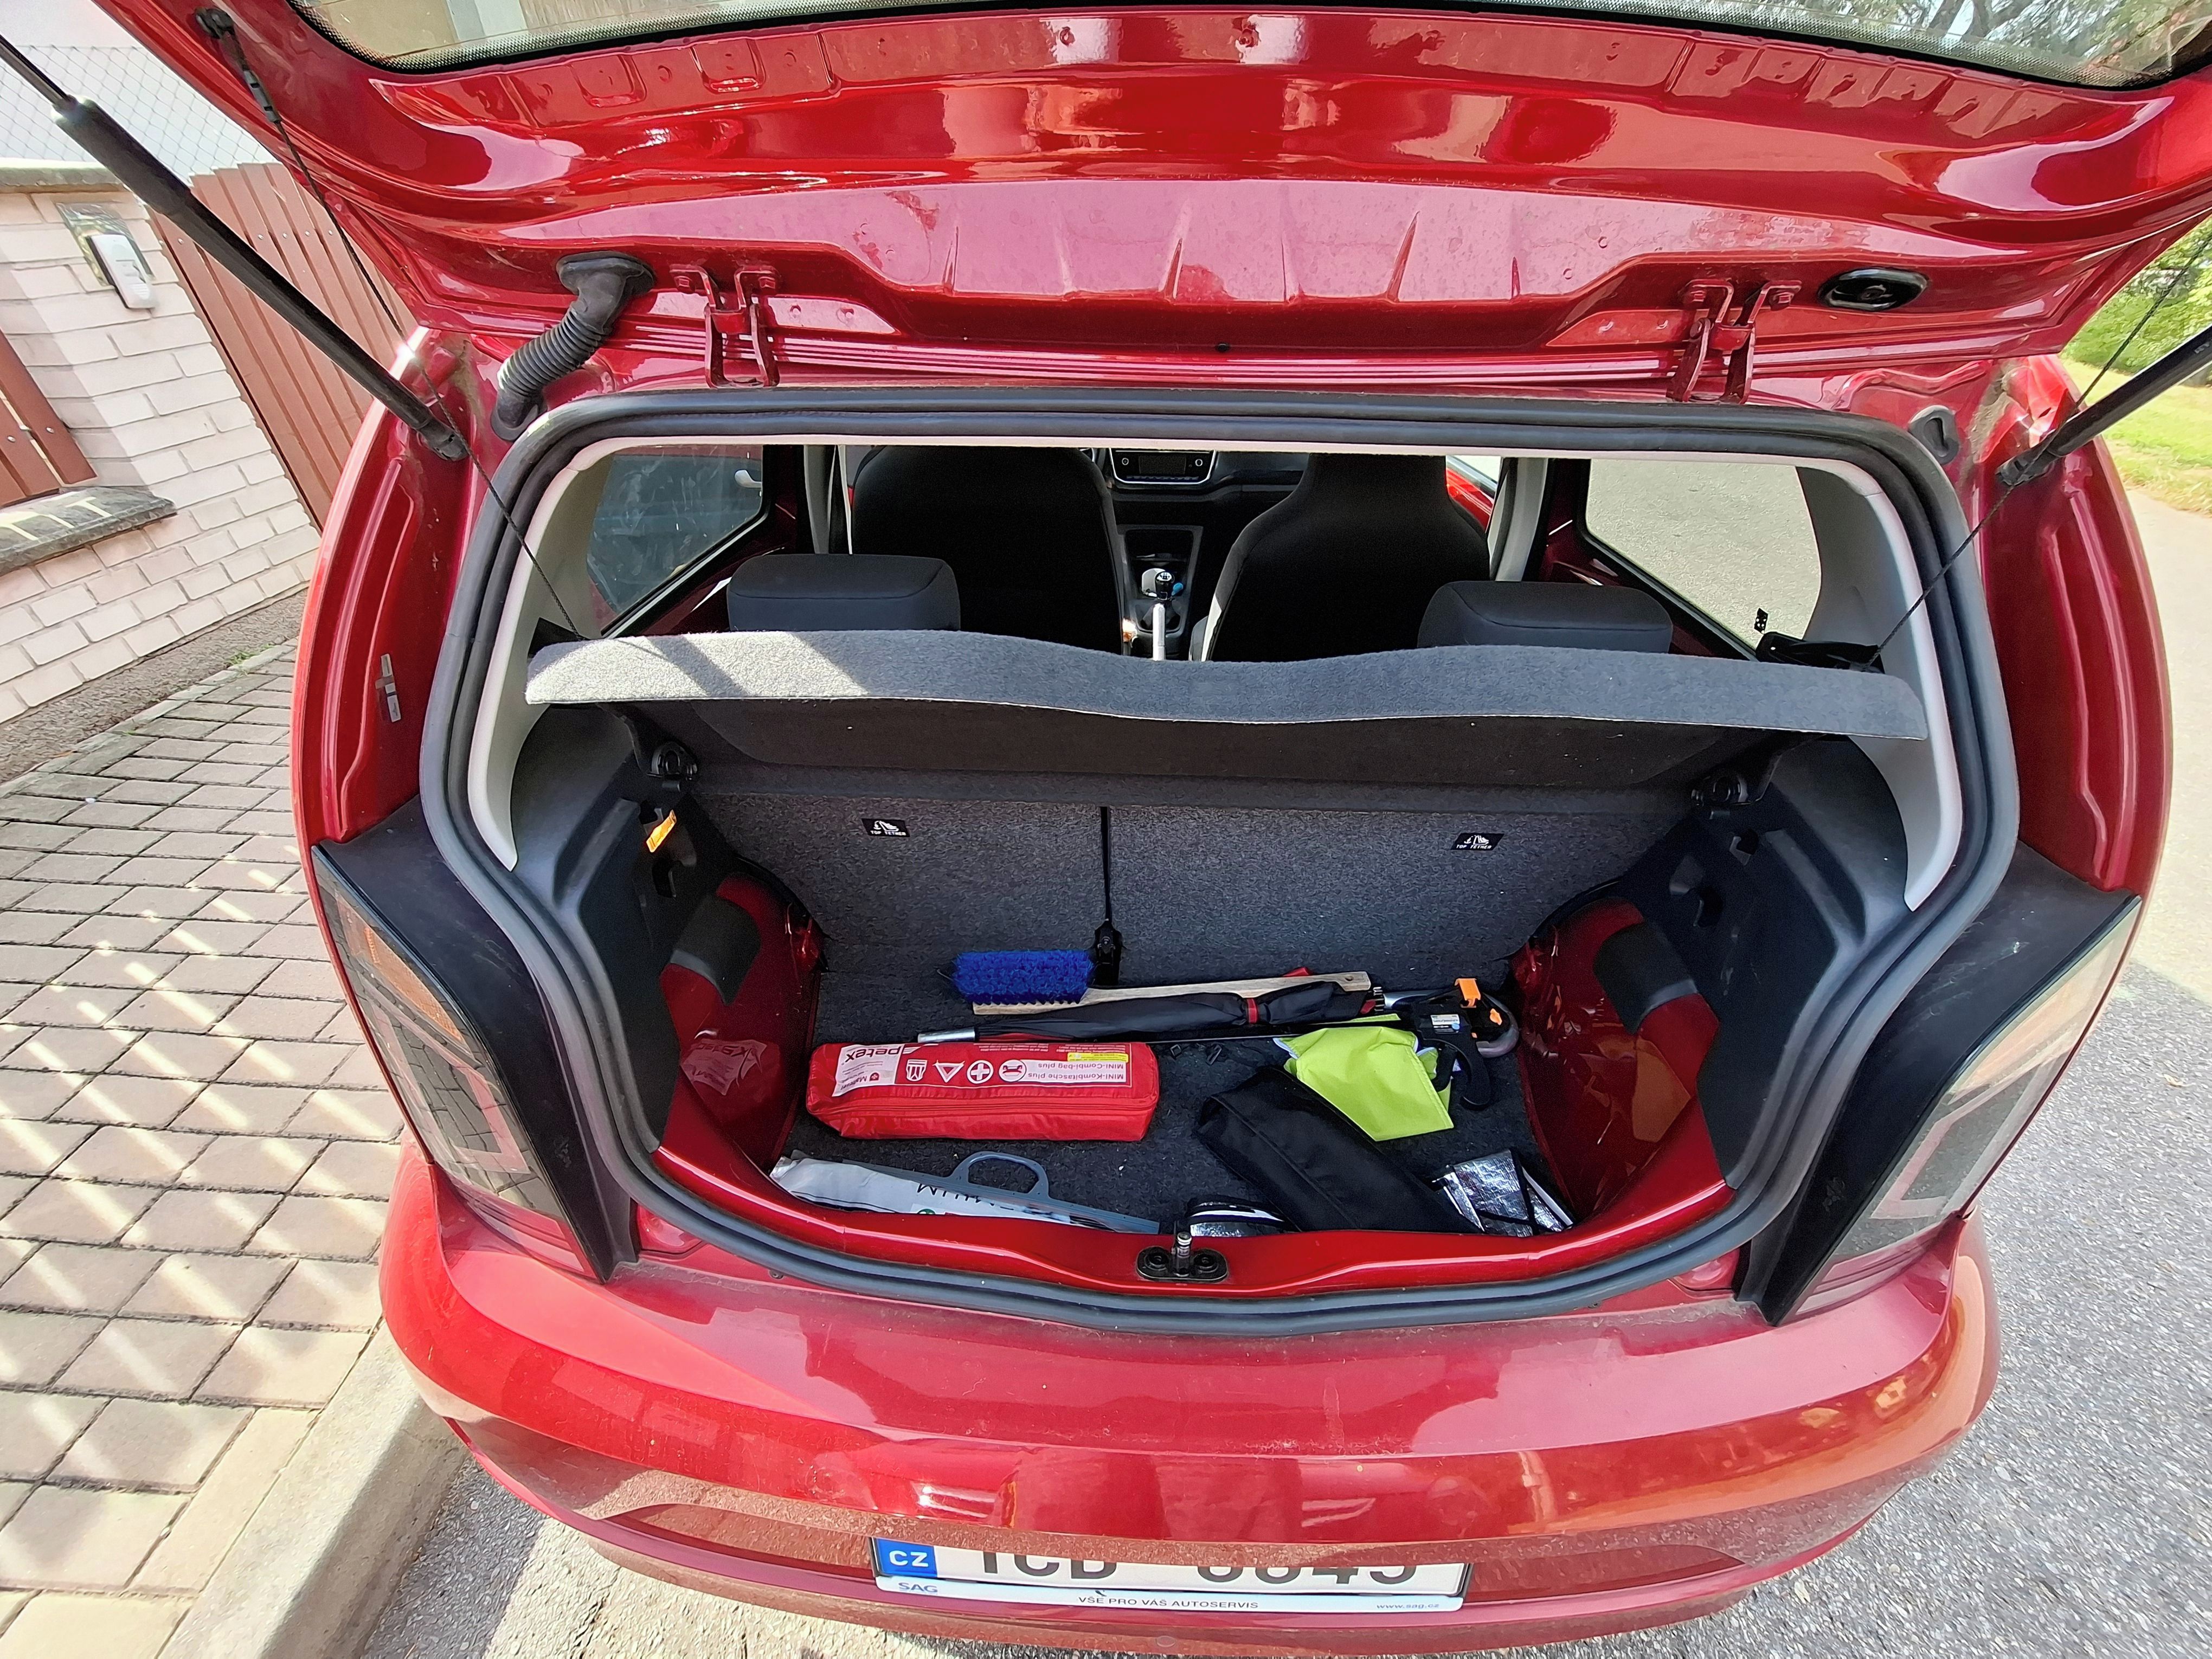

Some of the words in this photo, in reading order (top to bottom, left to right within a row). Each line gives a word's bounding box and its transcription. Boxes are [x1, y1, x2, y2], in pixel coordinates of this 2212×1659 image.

[845, 1046, 901, 1063] petex
[889, 1550, 929, 1567] CZ
[898, 1581, 938, 1593] SAG
[1078, 1596, 1104, 1604] VŠE
[1141, 1598, 1167, 1606] VÁŠ
[1172, 1600, 1259, 1609] AUTOSERVIS
